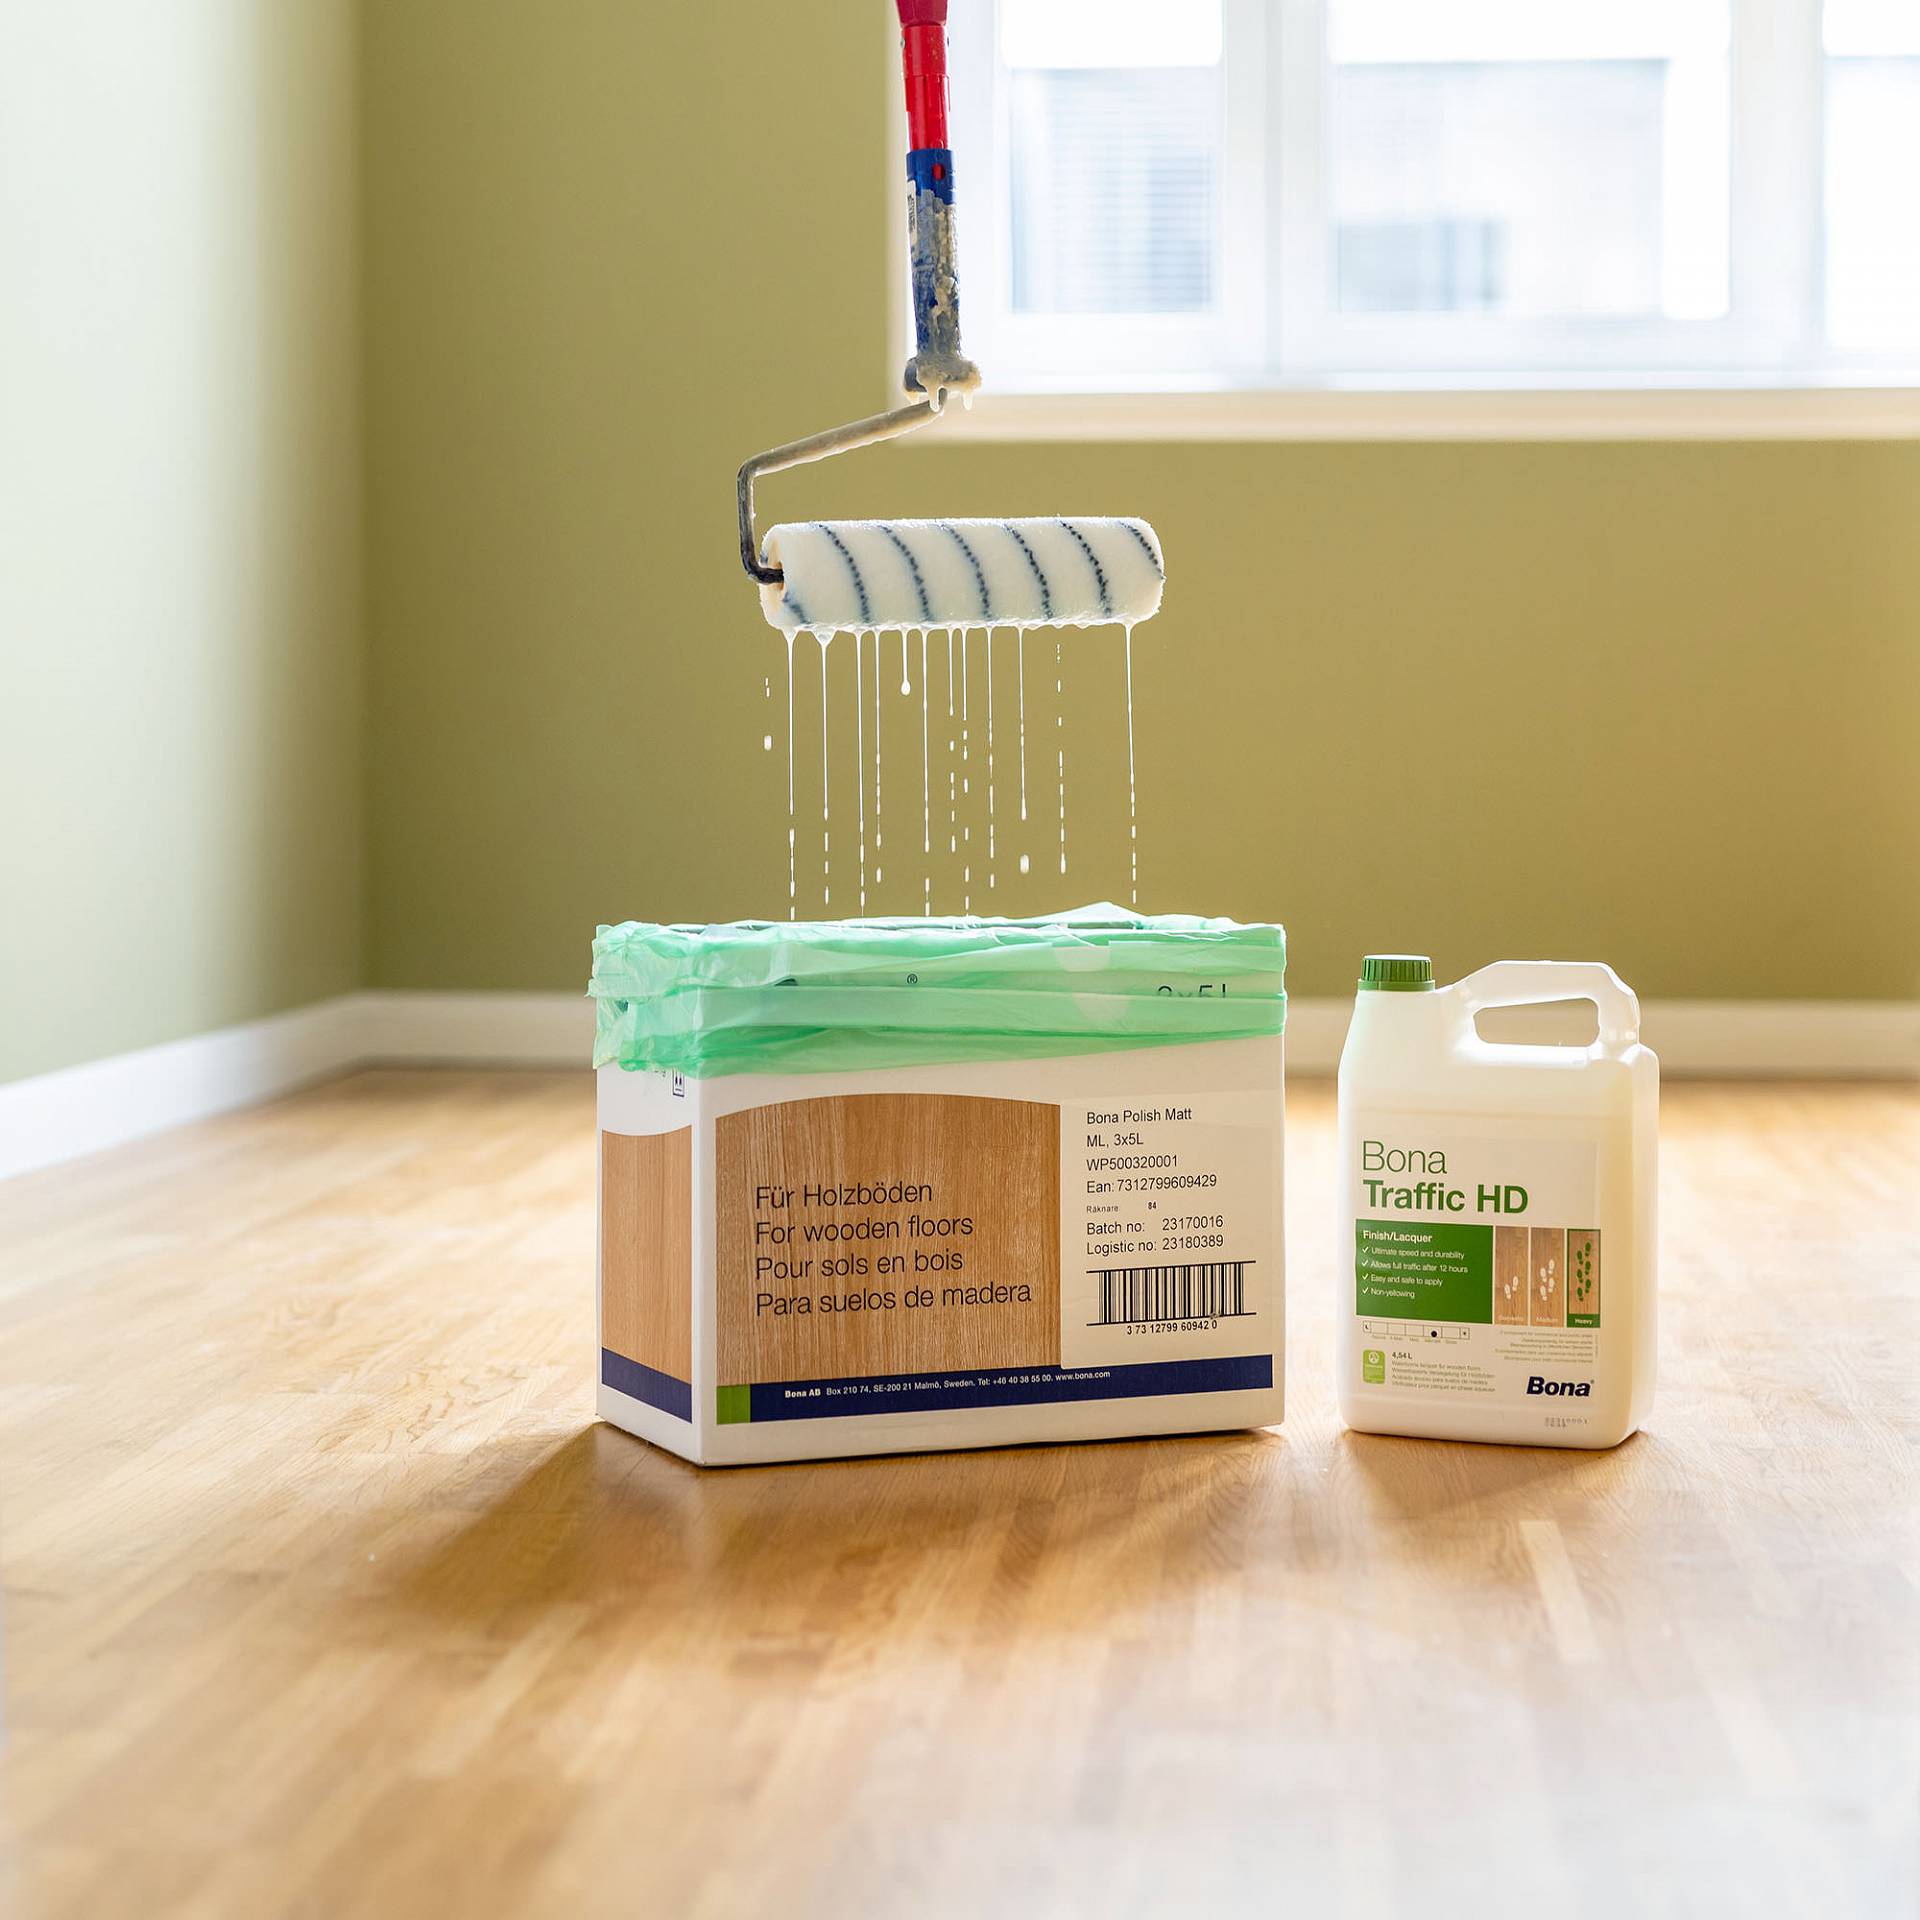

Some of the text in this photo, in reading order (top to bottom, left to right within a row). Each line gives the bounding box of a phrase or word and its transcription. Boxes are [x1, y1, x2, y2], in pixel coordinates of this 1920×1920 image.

[1087, 1108, 1192, 1125] Bona Polish Matt
[1087, 1133, 1144, 1148] ML, 3x5L
[1086, 1155, 1178, 1171] WP500320001
[1363, 1140, 1447, 1174] Bona
[1087, 1174, 1217, 1193] Ean: 7312799609429
[756, 1181, 932, 1209] Für Holzböden
[1363, 1179, 1529, 1214] Traffic HD
[1148, 1201, 1157, 1210] 84
[756, 1215, 974, 1245] For wooden floors
[1087, 1215, 1223, 1235] Batch no: 23170016
[1087, 1234, 1224, 1257] Logistic no: 23180389
[1363, 1230, 1433, 1244] Finish/Lacquer
[1371, 1247, 1397, 1256] Ultimate
[1399, 1249, 1419, 1258] speed
[1434, 1251, 1465, 1260] durability
[756, 1248, 963, 1280] Pour sols en bois
[1370, 1261, 1391, 1269] Allows
[1403, 1263, 1421, 1271] traffic
[1448, 1265, 1468, 1273] hours
[1370, 1274, 1386, 1283] Easy
[1387, 1275, 1400, 1283] and
[1424, 1278, 1443, 1287] apply
[756, 1282, 1032, 1316] Para suelos de madera
[1127, 1320, 1217, 1335] 3 73 12799 60942 0
[784, 1390, 807, 1398] Bona
[809, 1389, 821, 1397] AB
[826, 1387, 841, 1396] Box
[843, 1386, 857, 1394] 210
[873, 1383, 901, 1392] SE-200
[903, 1382, 912, 1390] 21
[978, 1378, 991, 1386] Tel:
[993, 1376, 1007, 1385] +46
[1008, 1376, 1018, 1384] 40
[1019, 1375, 1029, 1384] 38
[1031, 1374, 1040, 1383] 55
[1055, 1371, 1111, 1381] www.bona.com
[1526, 1376, 1591, 1397] Bona
